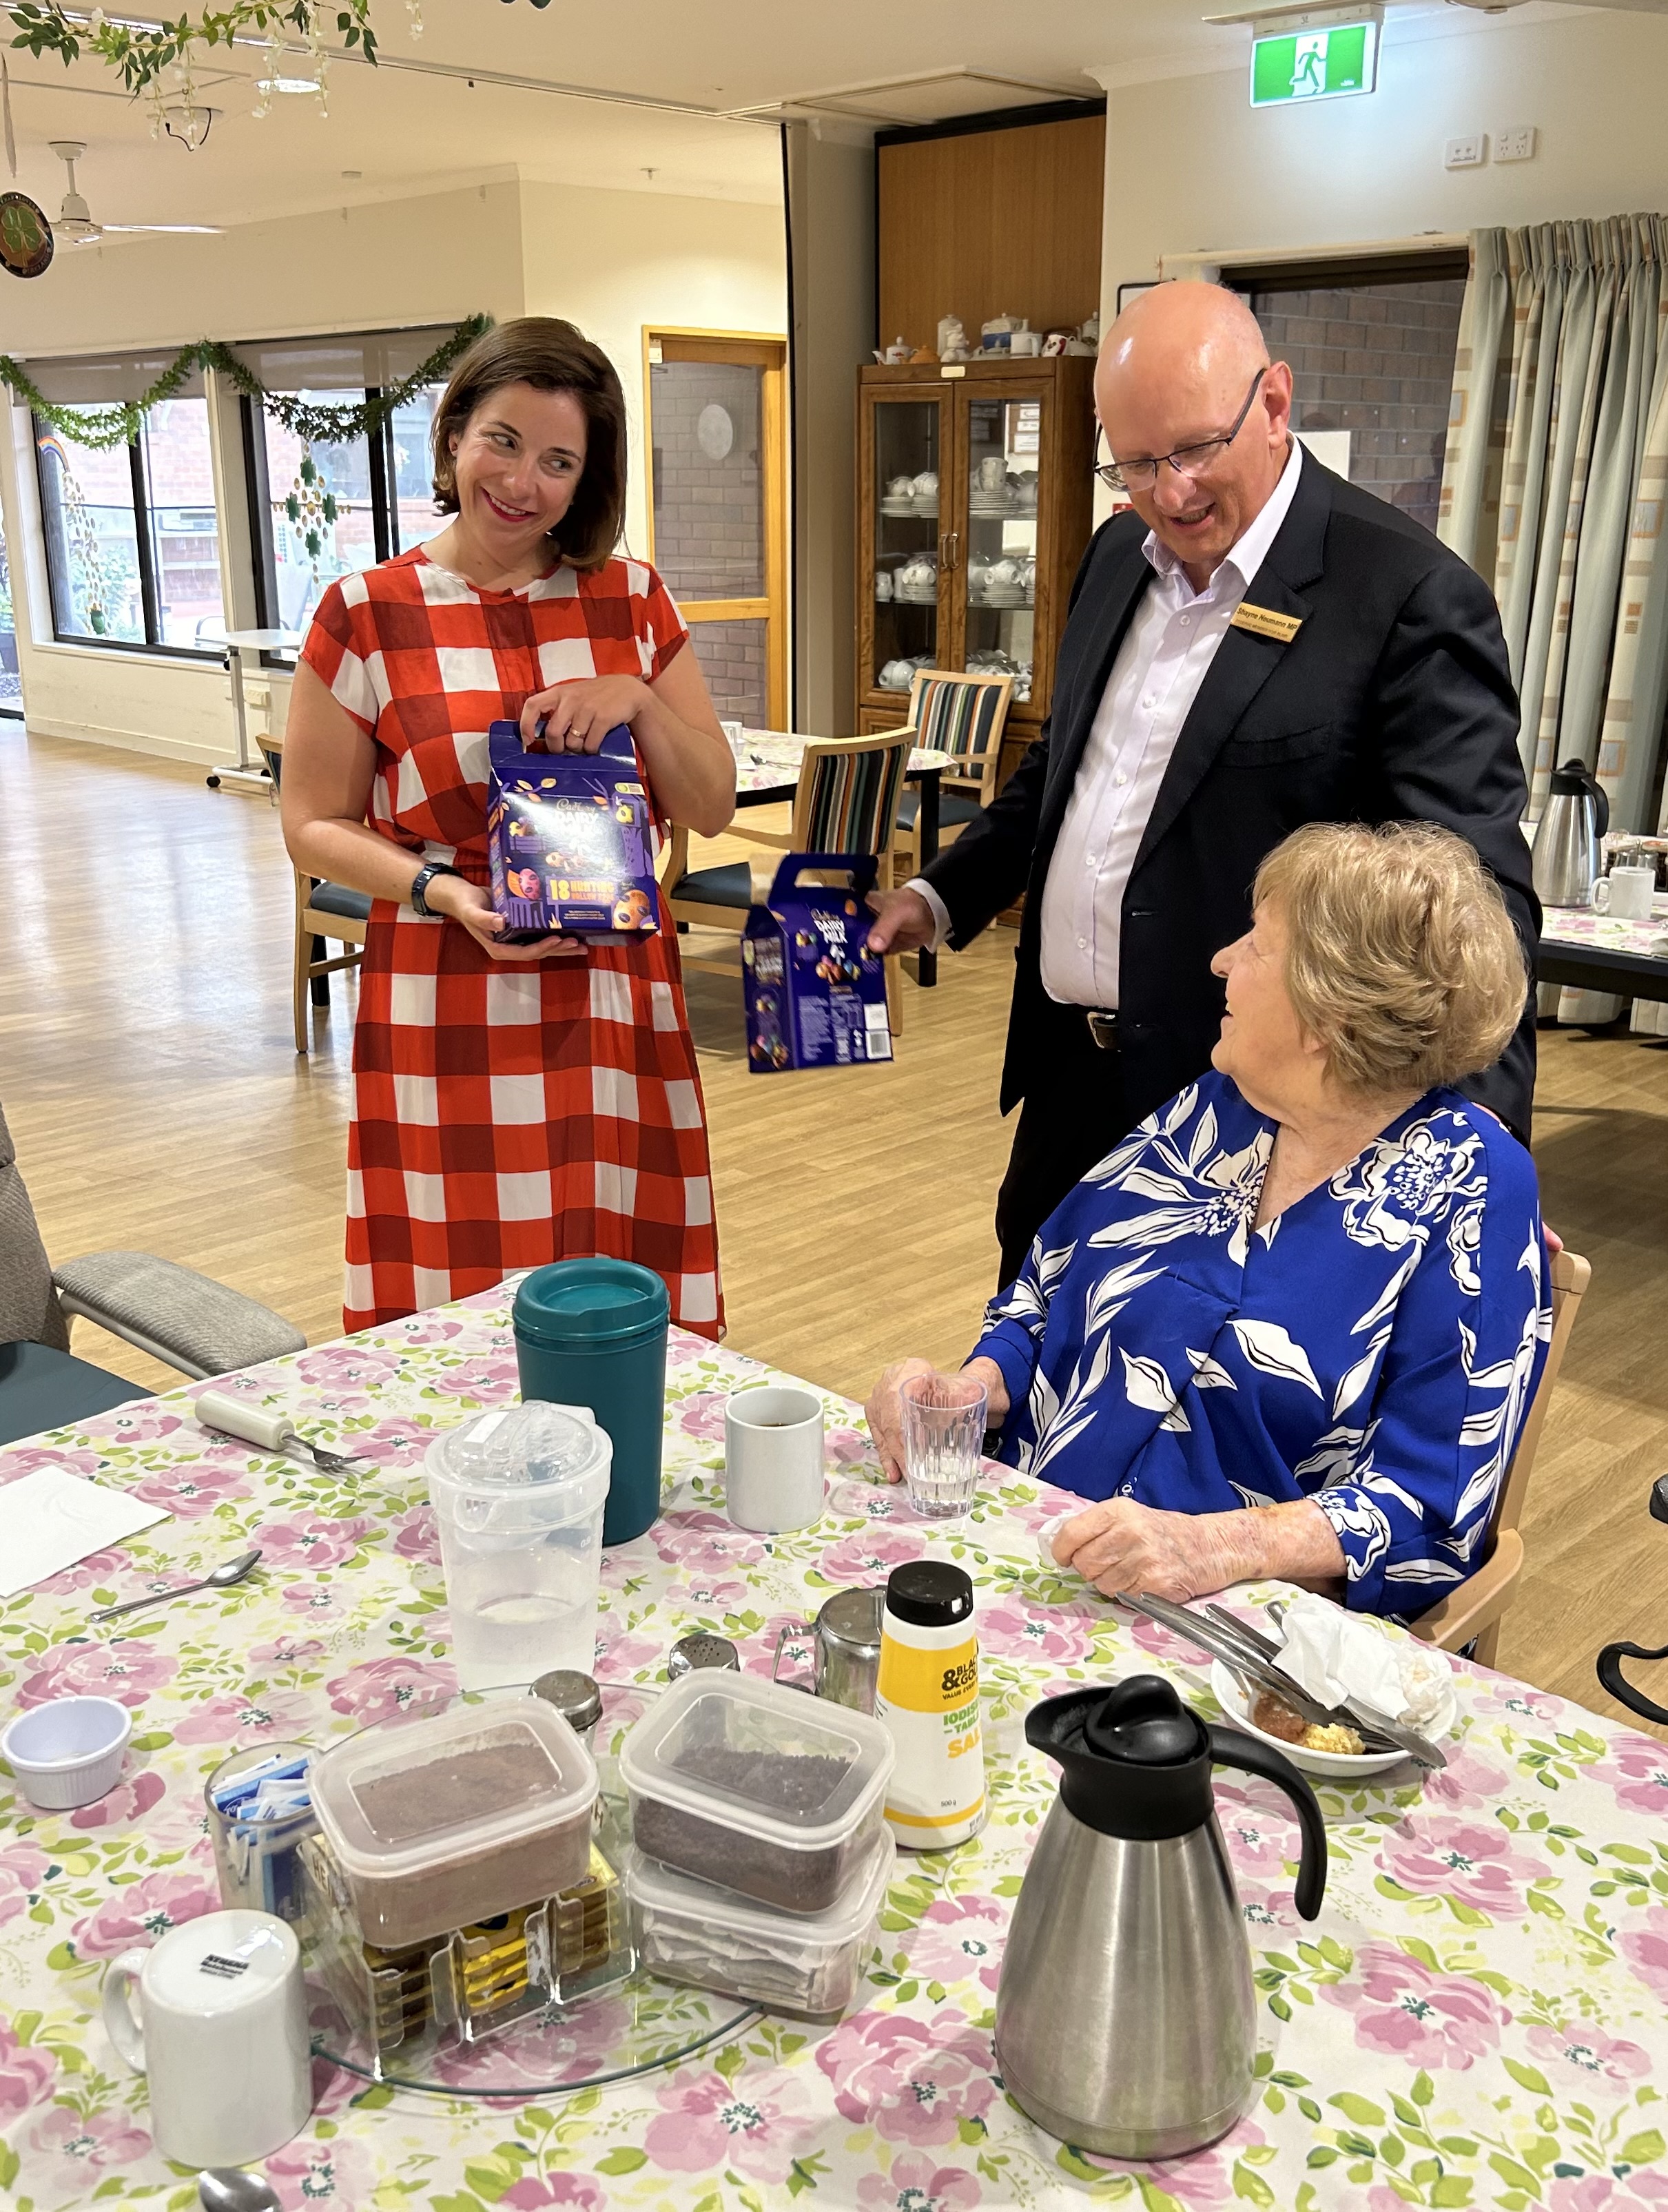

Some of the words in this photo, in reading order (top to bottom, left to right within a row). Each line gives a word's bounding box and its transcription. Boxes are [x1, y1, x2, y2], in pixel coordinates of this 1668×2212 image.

[1237, 608, 1259, 619] Shayne
[1259, 614, 1286, 628] Neumann
[1286, 622, 1298, 630] MP
[555, 811, 599, 825] DAIRY
[550, 880, 570, 900] 18
[956, 1651, 978, 1676] BLAC
[942, 1668, 960, 1691] &
[960, 1667, 977, 1684] GOL
[942, 1689, 962, 1700] VALUE
[954, 1711, 979, 1733] TABL
[947, 1726, 980, 1759] SAL
